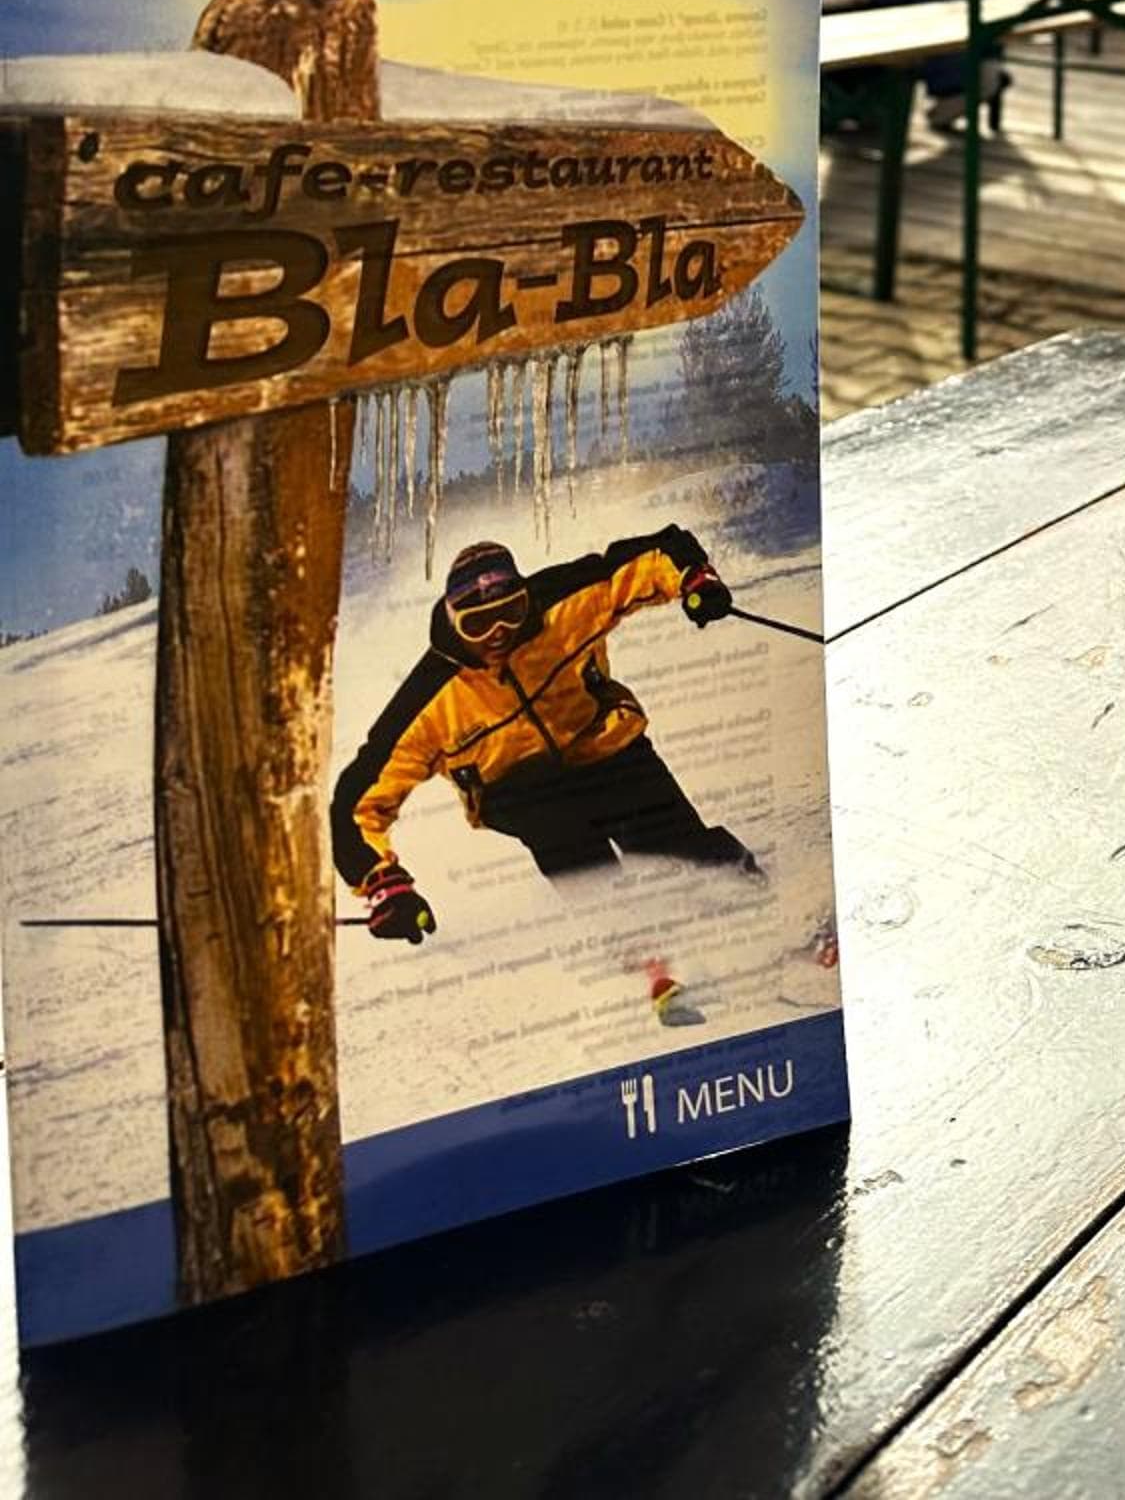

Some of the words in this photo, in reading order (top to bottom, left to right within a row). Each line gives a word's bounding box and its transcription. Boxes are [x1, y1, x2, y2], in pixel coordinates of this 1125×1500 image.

[113, 143, 714, 219] cafe-restaurant
[111, 215, 722, 407] Bla-Bla
[677, 1059, 794, 1124] MENU
